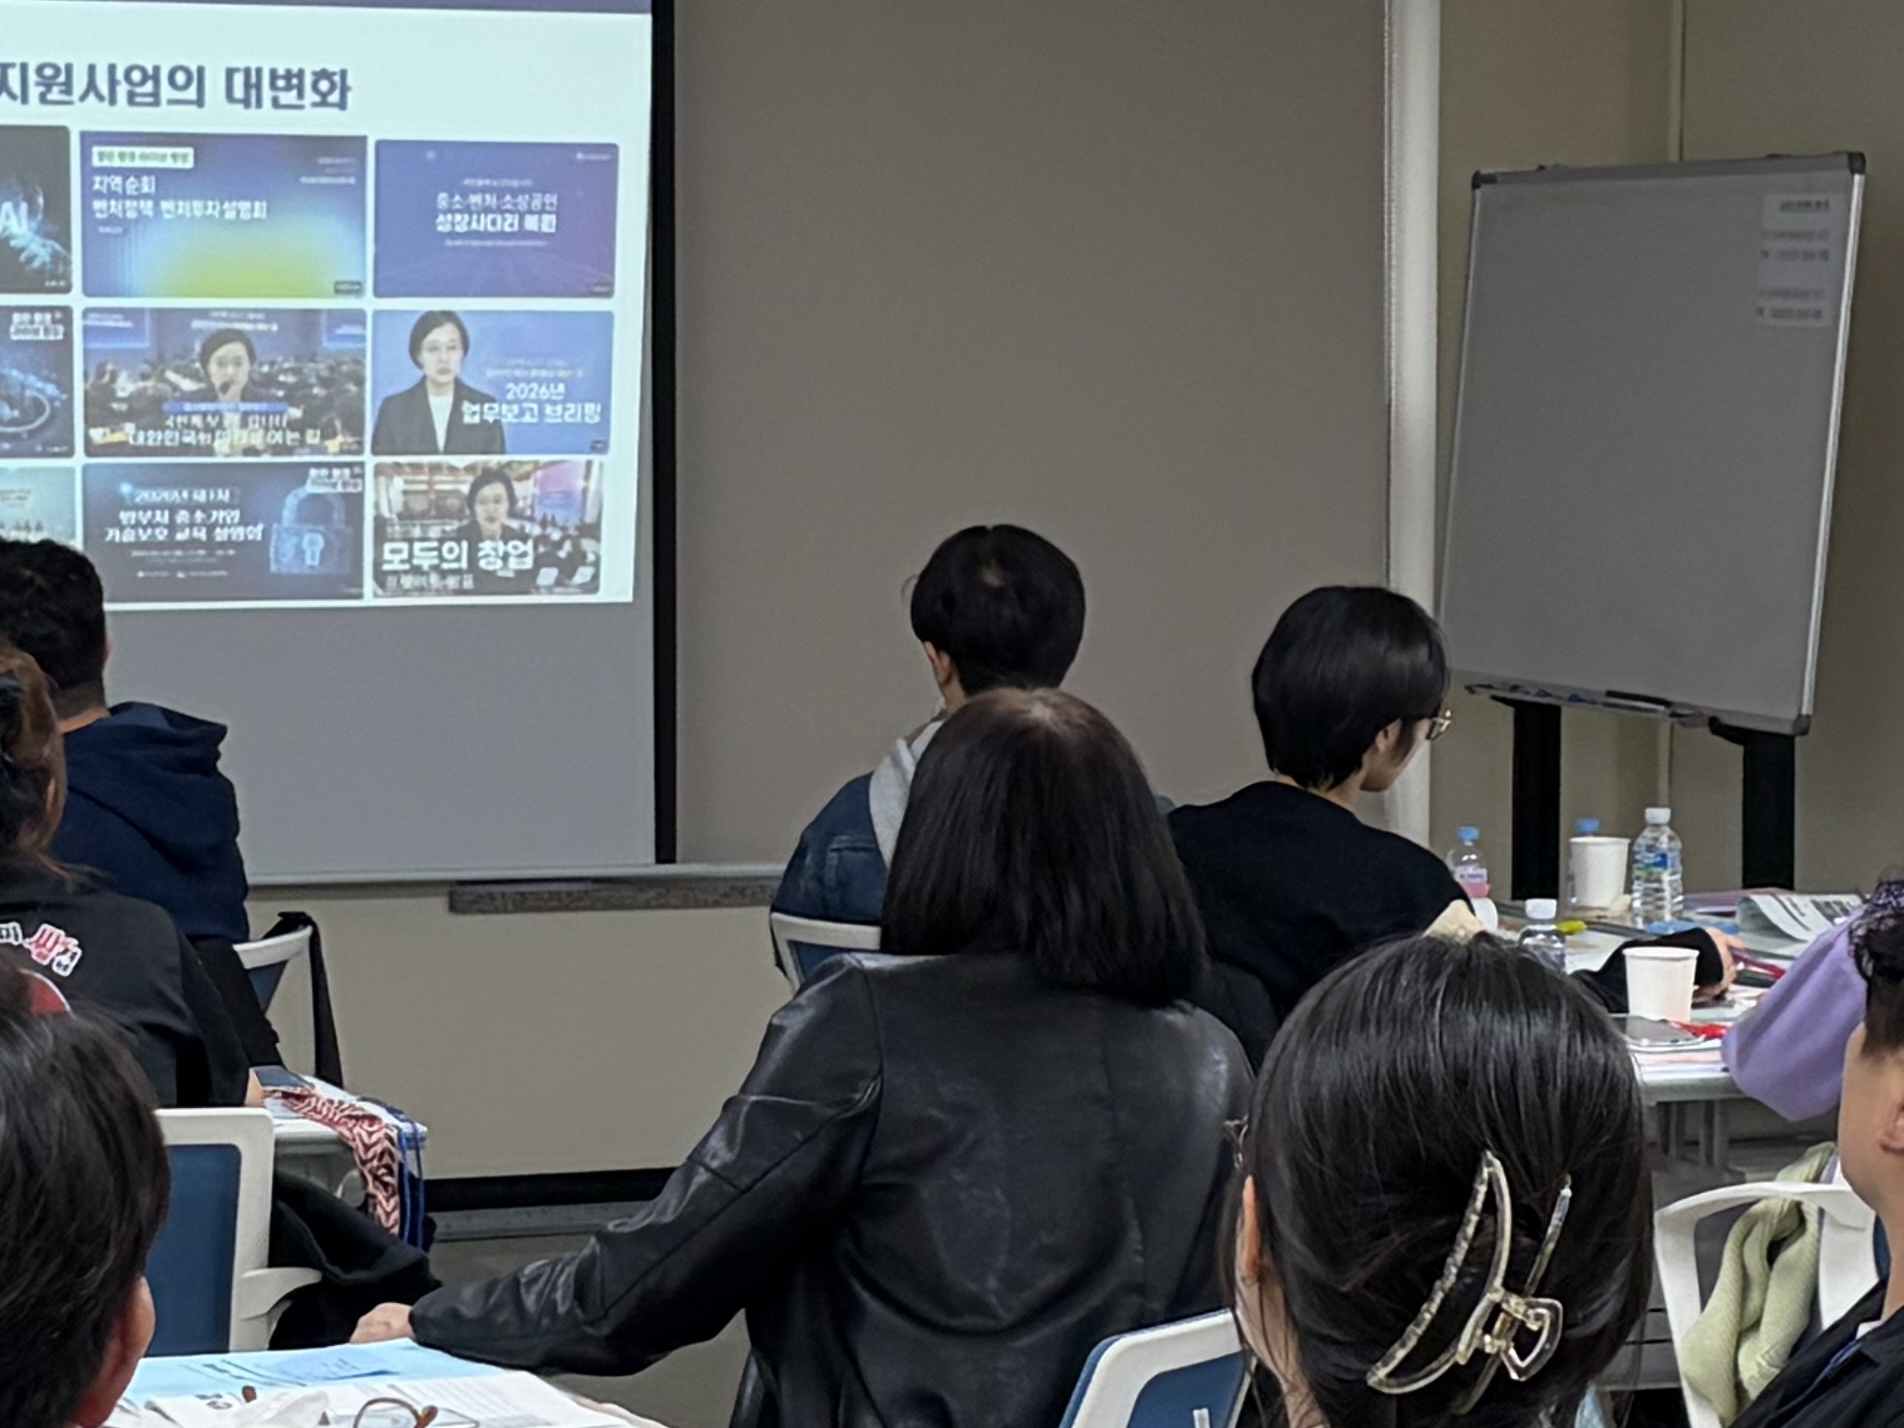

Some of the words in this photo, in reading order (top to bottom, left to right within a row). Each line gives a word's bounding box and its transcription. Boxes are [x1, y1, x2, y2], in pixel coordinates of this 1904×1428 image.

[225, 66, 353, 111] 대변화
[505, 383, 566, 400] 2026년
[381, 539, 469, 571] 모두의
[477, 538, 534, 571] 창업
